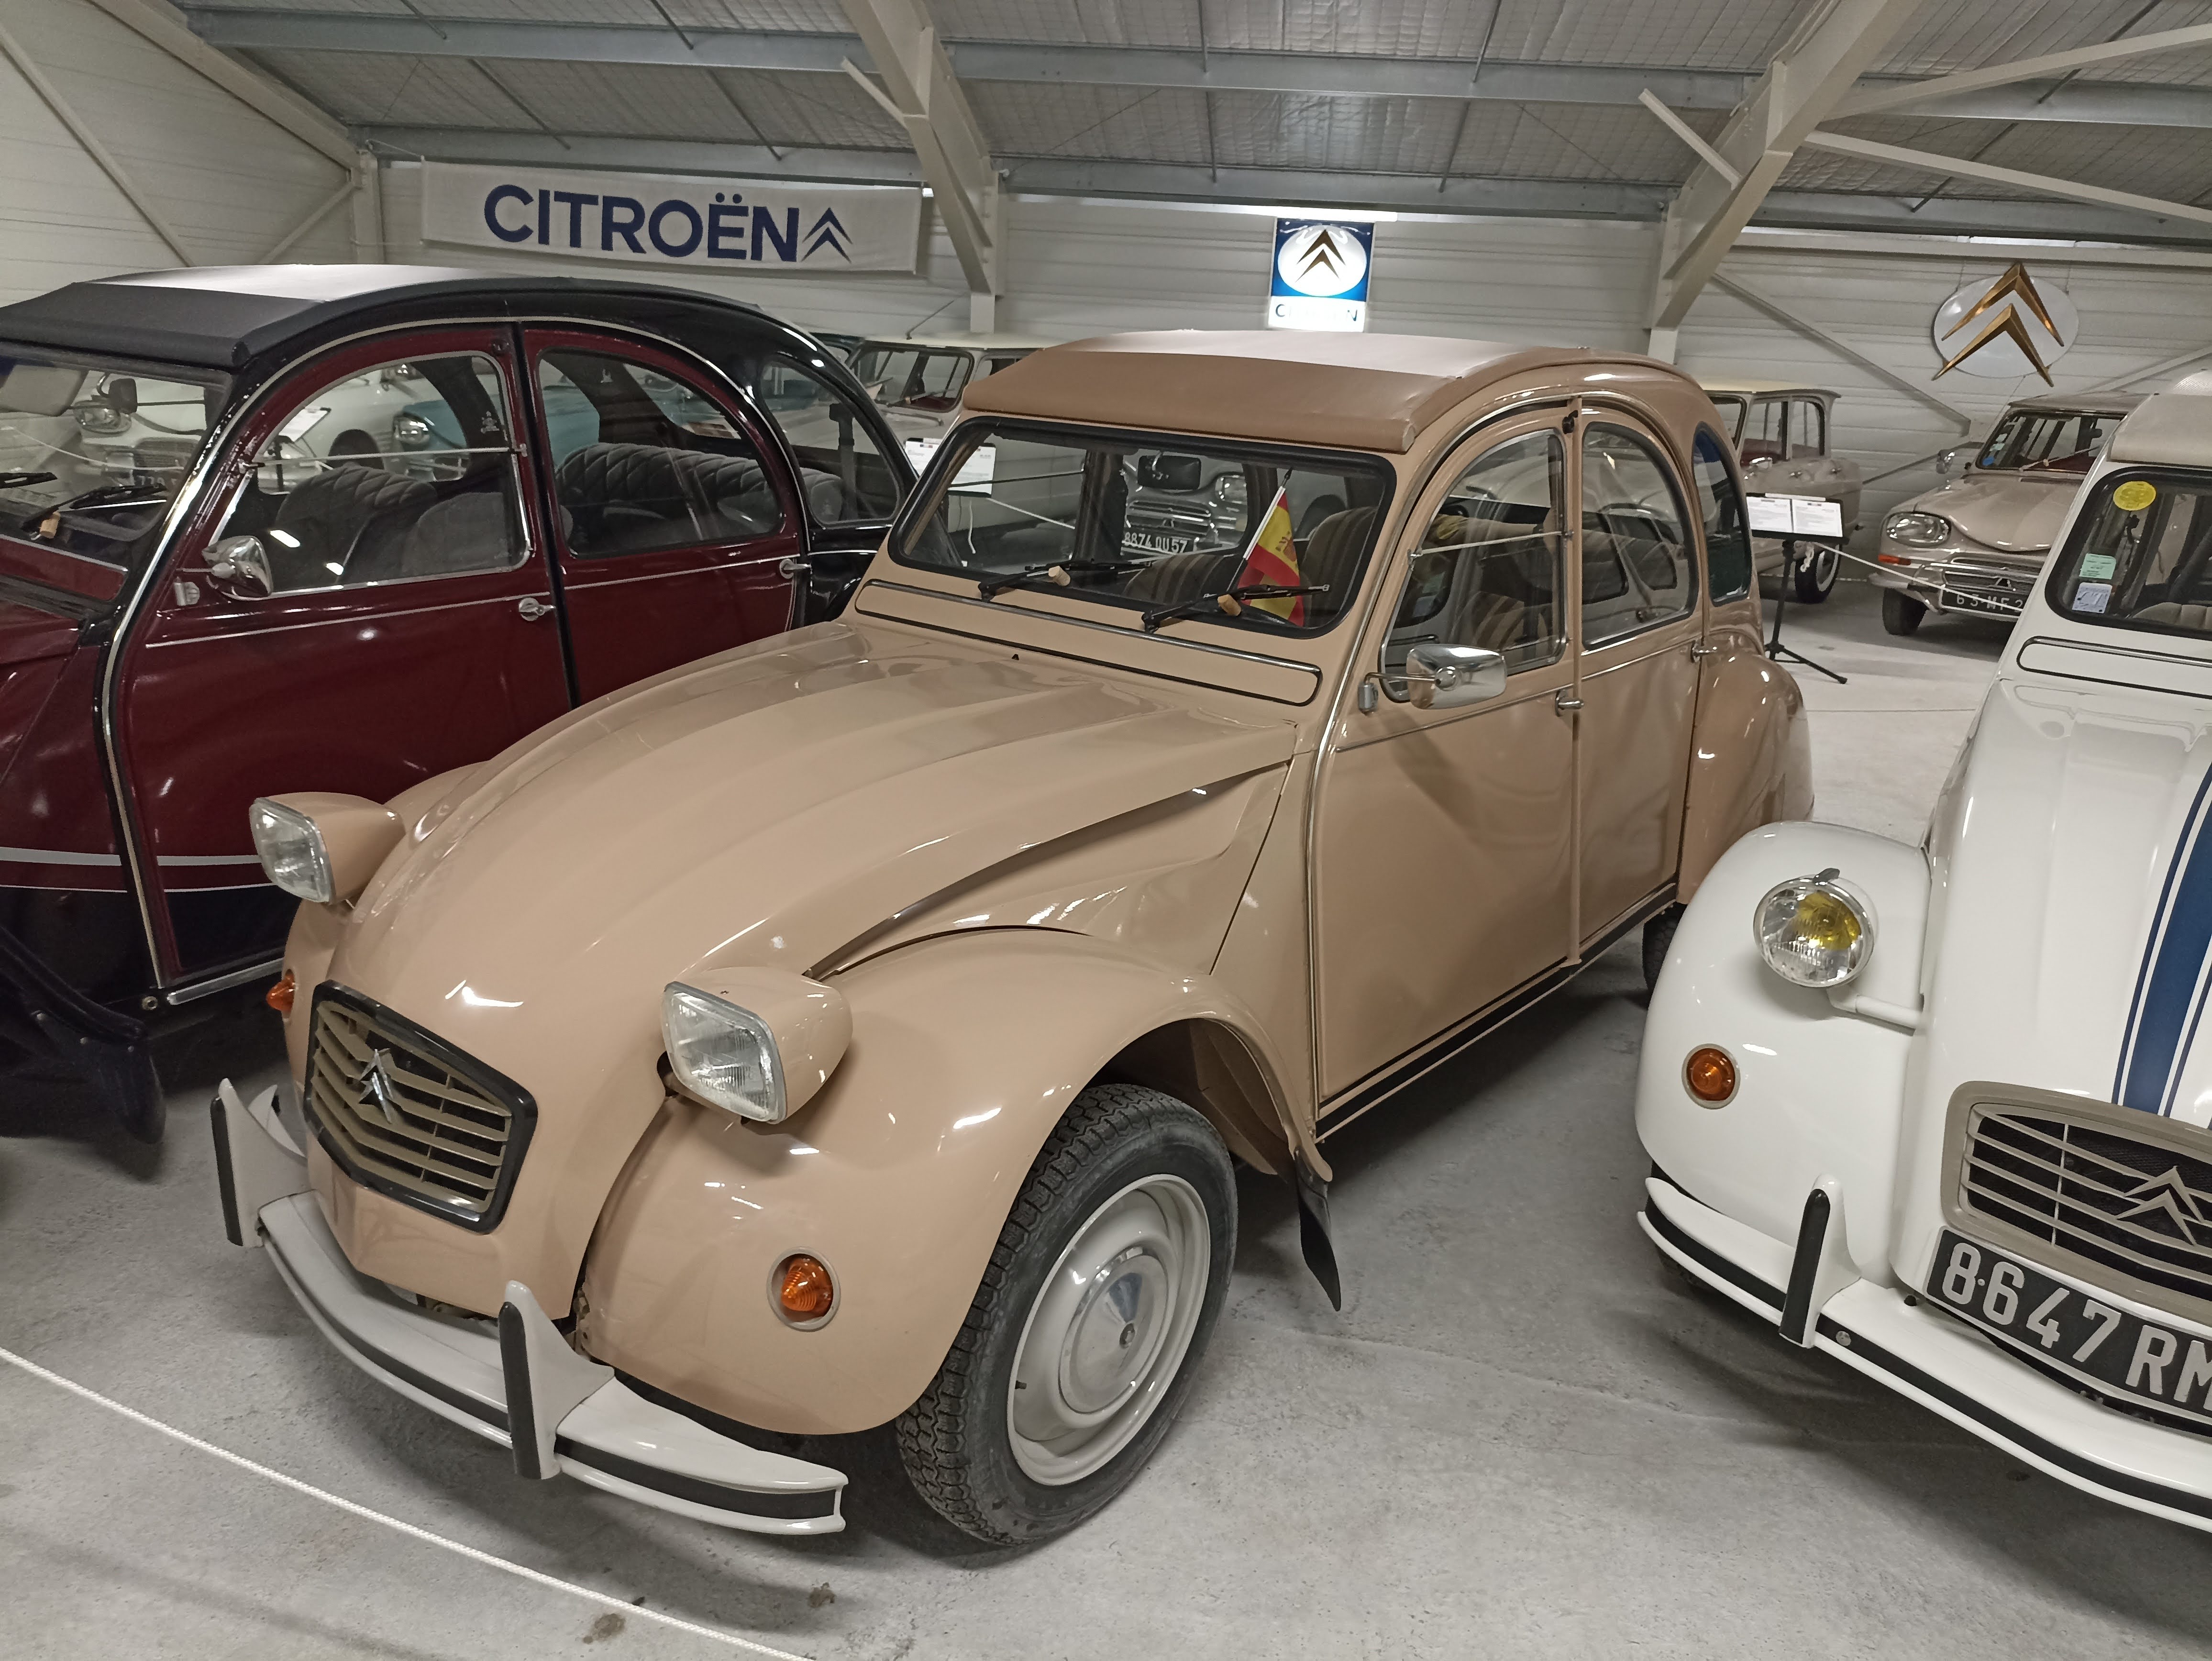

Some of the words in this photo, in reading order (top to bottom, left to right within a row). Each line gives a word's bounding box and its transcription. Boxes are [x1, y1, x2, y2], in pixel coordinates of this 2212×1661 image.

[484, 184, 799, 262] CITROËN
[1124, 532, 1152, 548] 8874
[1942, 1242, 2122, 1363] 8647
[2125, 1324, 2212, 1411] RM
